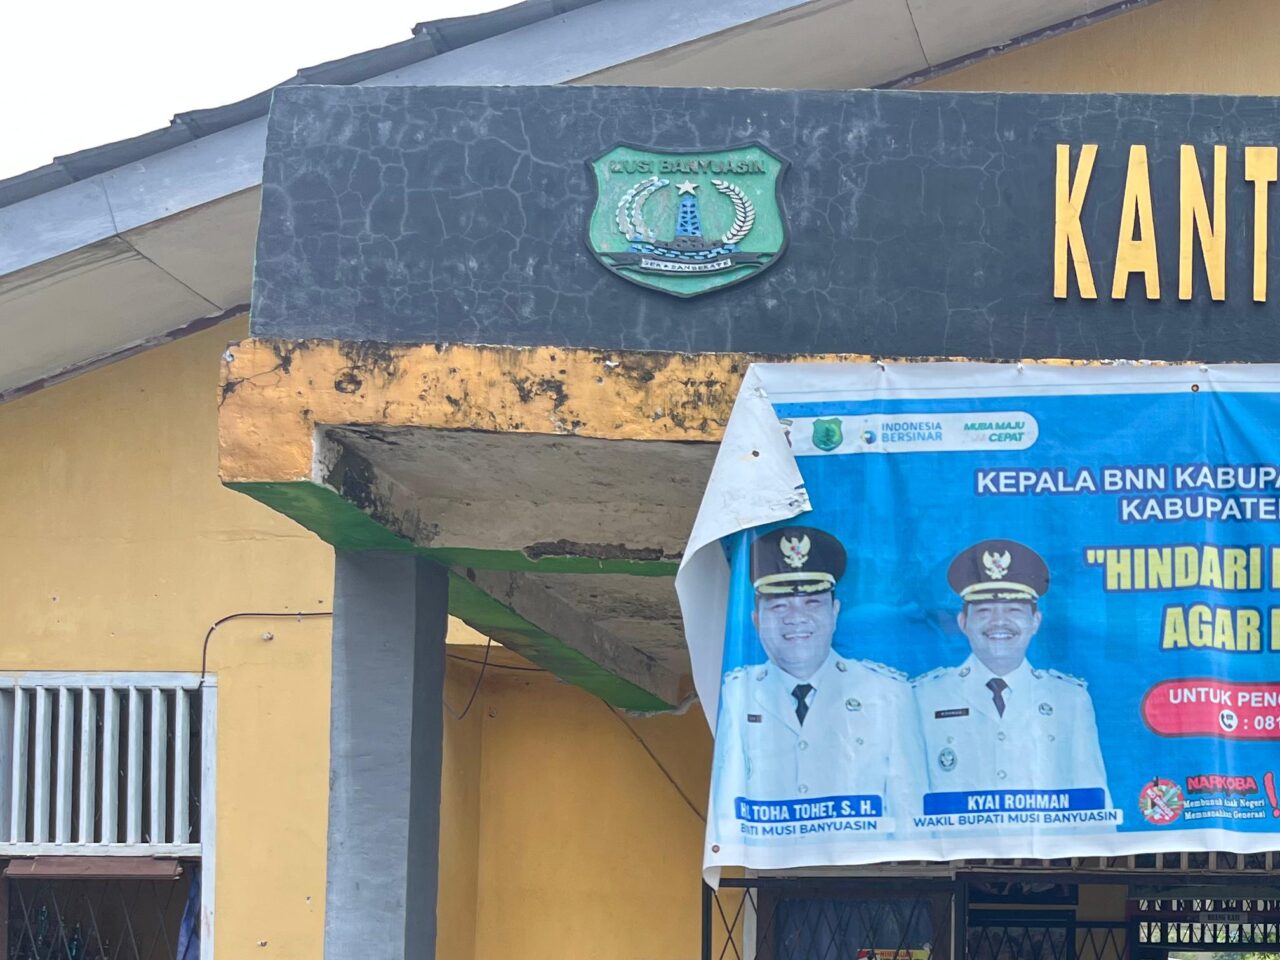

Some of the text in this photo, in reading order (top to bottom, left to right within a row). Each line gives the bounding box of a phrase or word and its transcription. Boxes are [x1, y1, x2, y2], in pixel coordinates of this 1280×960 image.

[660, 159, 766, 174] BANYUASIN
[881, 421, 943, 432] INDONESIA
[995, 421, 1025, 430] MAJU
[881, 432, 943, 442] BERSINAR
[988, 432, 1025, 442] CEPAT
[976, 469, 1096, 493] KEPALA
[1104, 468, 1166, 491] BNN
[1086, 545, 1258, 591] "HINDARI
[1161, 604, 1262, 651] AGAR
[1168, 687, 1233, 707] UNTUK
[1186, 775, 1259, 793] NARKOBA
[752, 804, 790, 821] TOHA
[793, 801, 837, 819] TOHET,
[840, 800, 856, 816] S.
[860, 799, 877, 815] H.
[967, 793, 1070, 811] KYAI ROHMAN
[1240, 798, 1265, 809] Negeri
[762, 824, 796, 836] MUSI
[800, 820, 878, 834] BANYUASIN
[913, 811, 1118, 828] WAKIL BUPATI MUSI BANYUASIN
